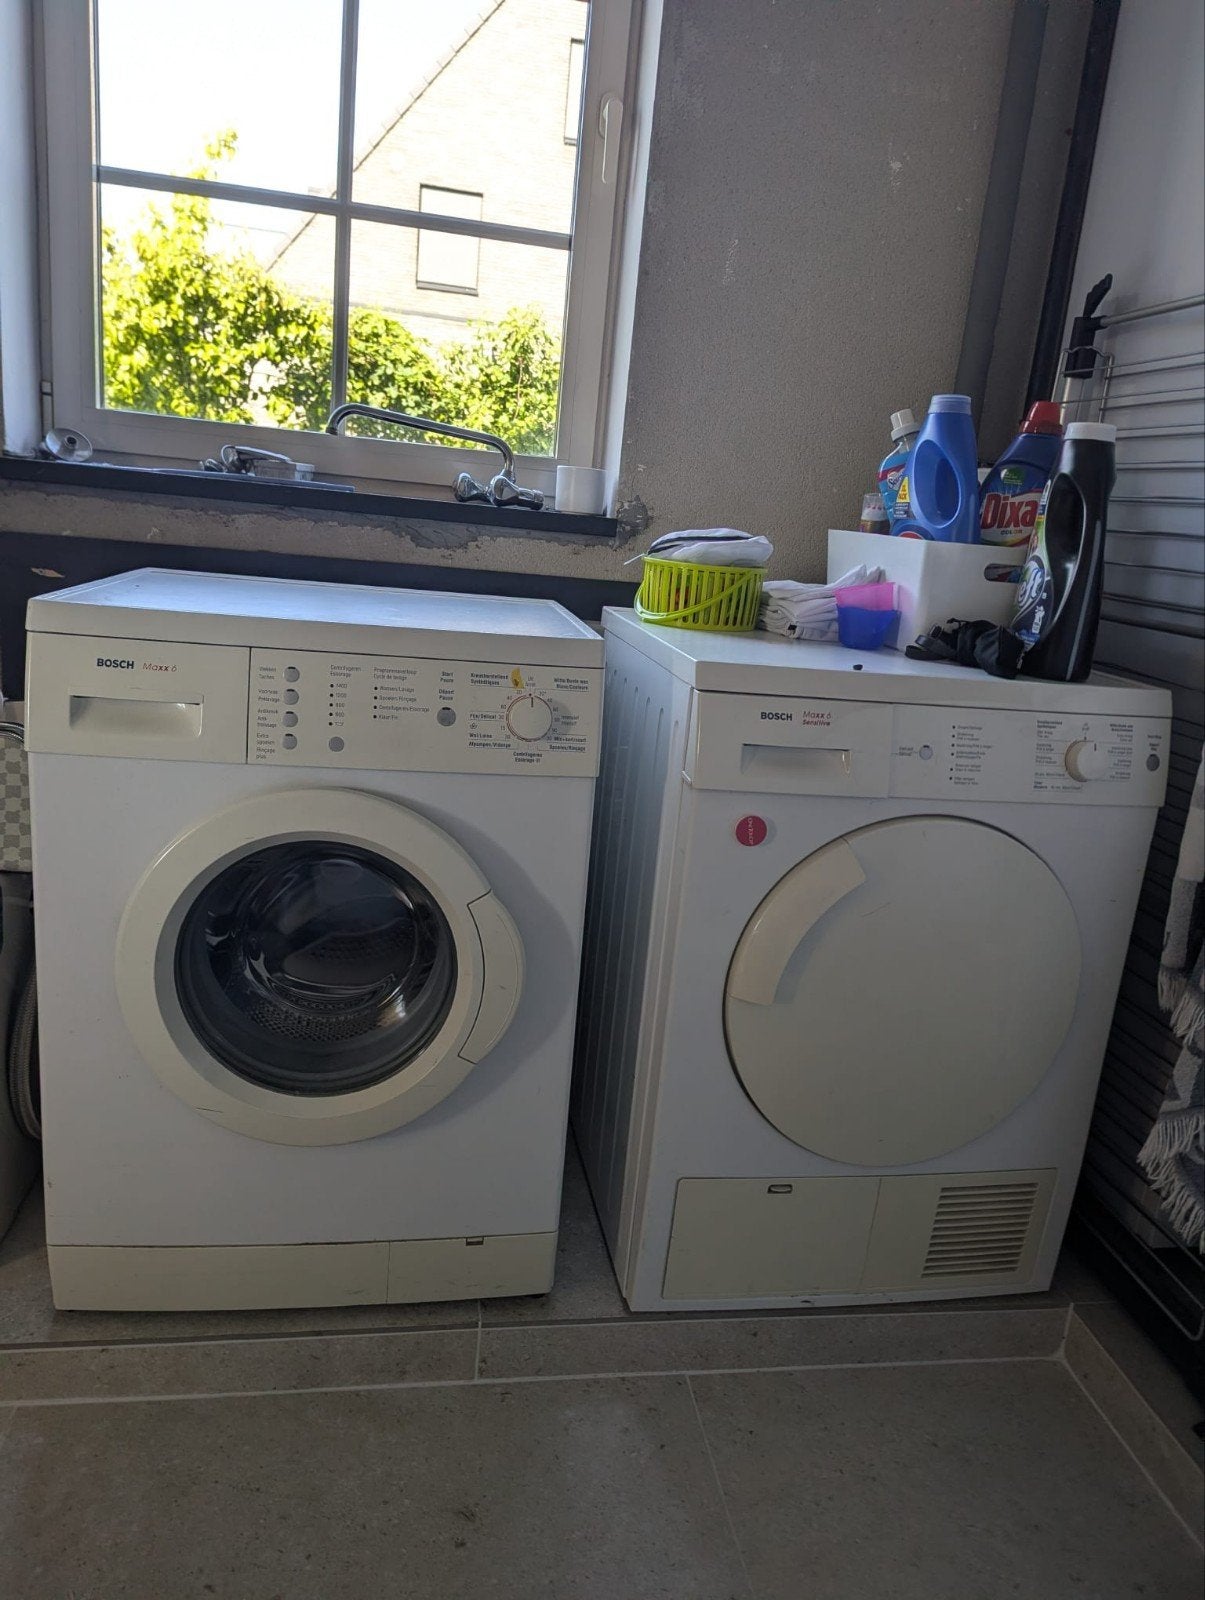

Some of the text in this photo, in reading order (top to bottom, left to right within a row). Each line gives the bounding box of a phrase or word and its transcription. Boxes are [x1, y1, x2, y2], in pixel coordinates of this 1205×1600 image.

[980, 493, 1038, 529] Dixa
[96, 658, 178, 673] BOSCH Maxx 6
[760, 711, 793, 721] BOSCH
[803, 711, 825, 719] Maxx
